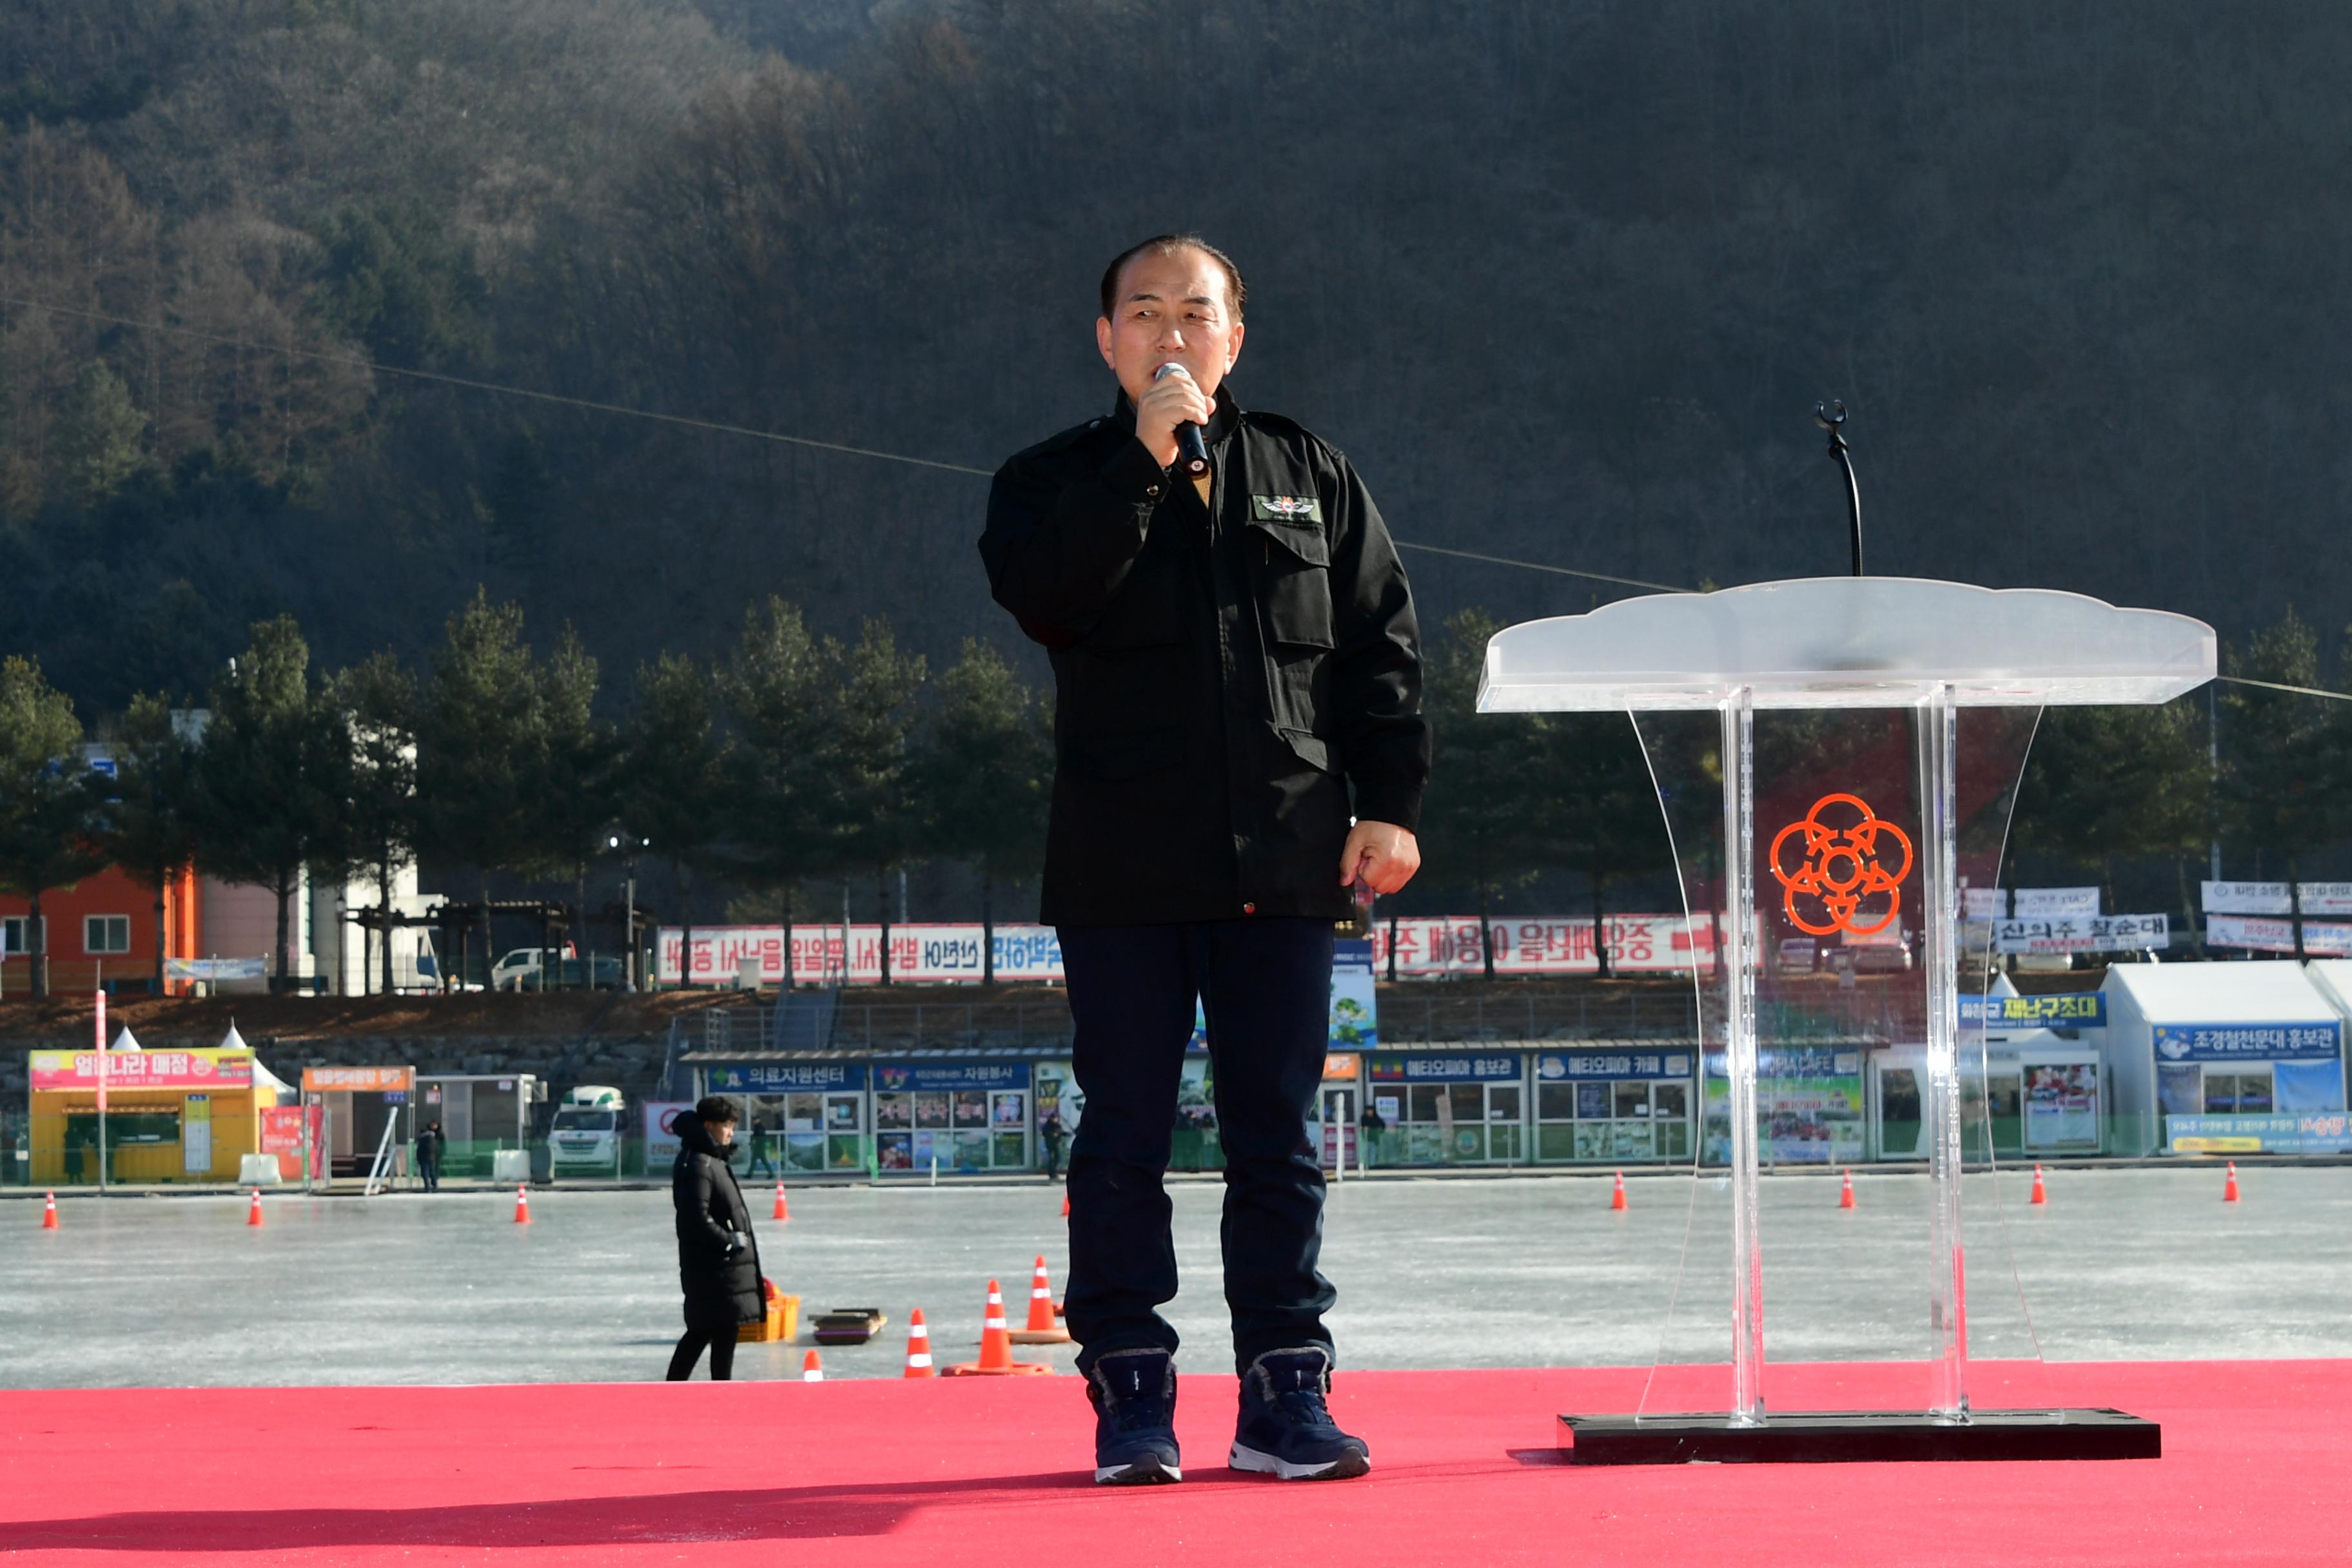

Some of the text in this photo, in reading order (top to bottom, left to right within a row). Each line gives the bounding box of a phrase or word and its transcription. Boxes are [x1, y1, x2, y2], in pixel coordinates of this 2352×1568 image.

[2001, 917, 2164, 940] 신의주 찰순대
[2003, 996, 2097, 1019] 재난구조대
[2193, 1028, 2334, 1051] 조경철천문대 홍보관
[152, 1054, 188, 1076] 매점
[749, 1066, 845, 1084] 의료지원센터
[1406, 1059, 1512, 1077] 에티오피아 홍보관
[1567, 1056, 1660, 1075] 에티오피아 카페
